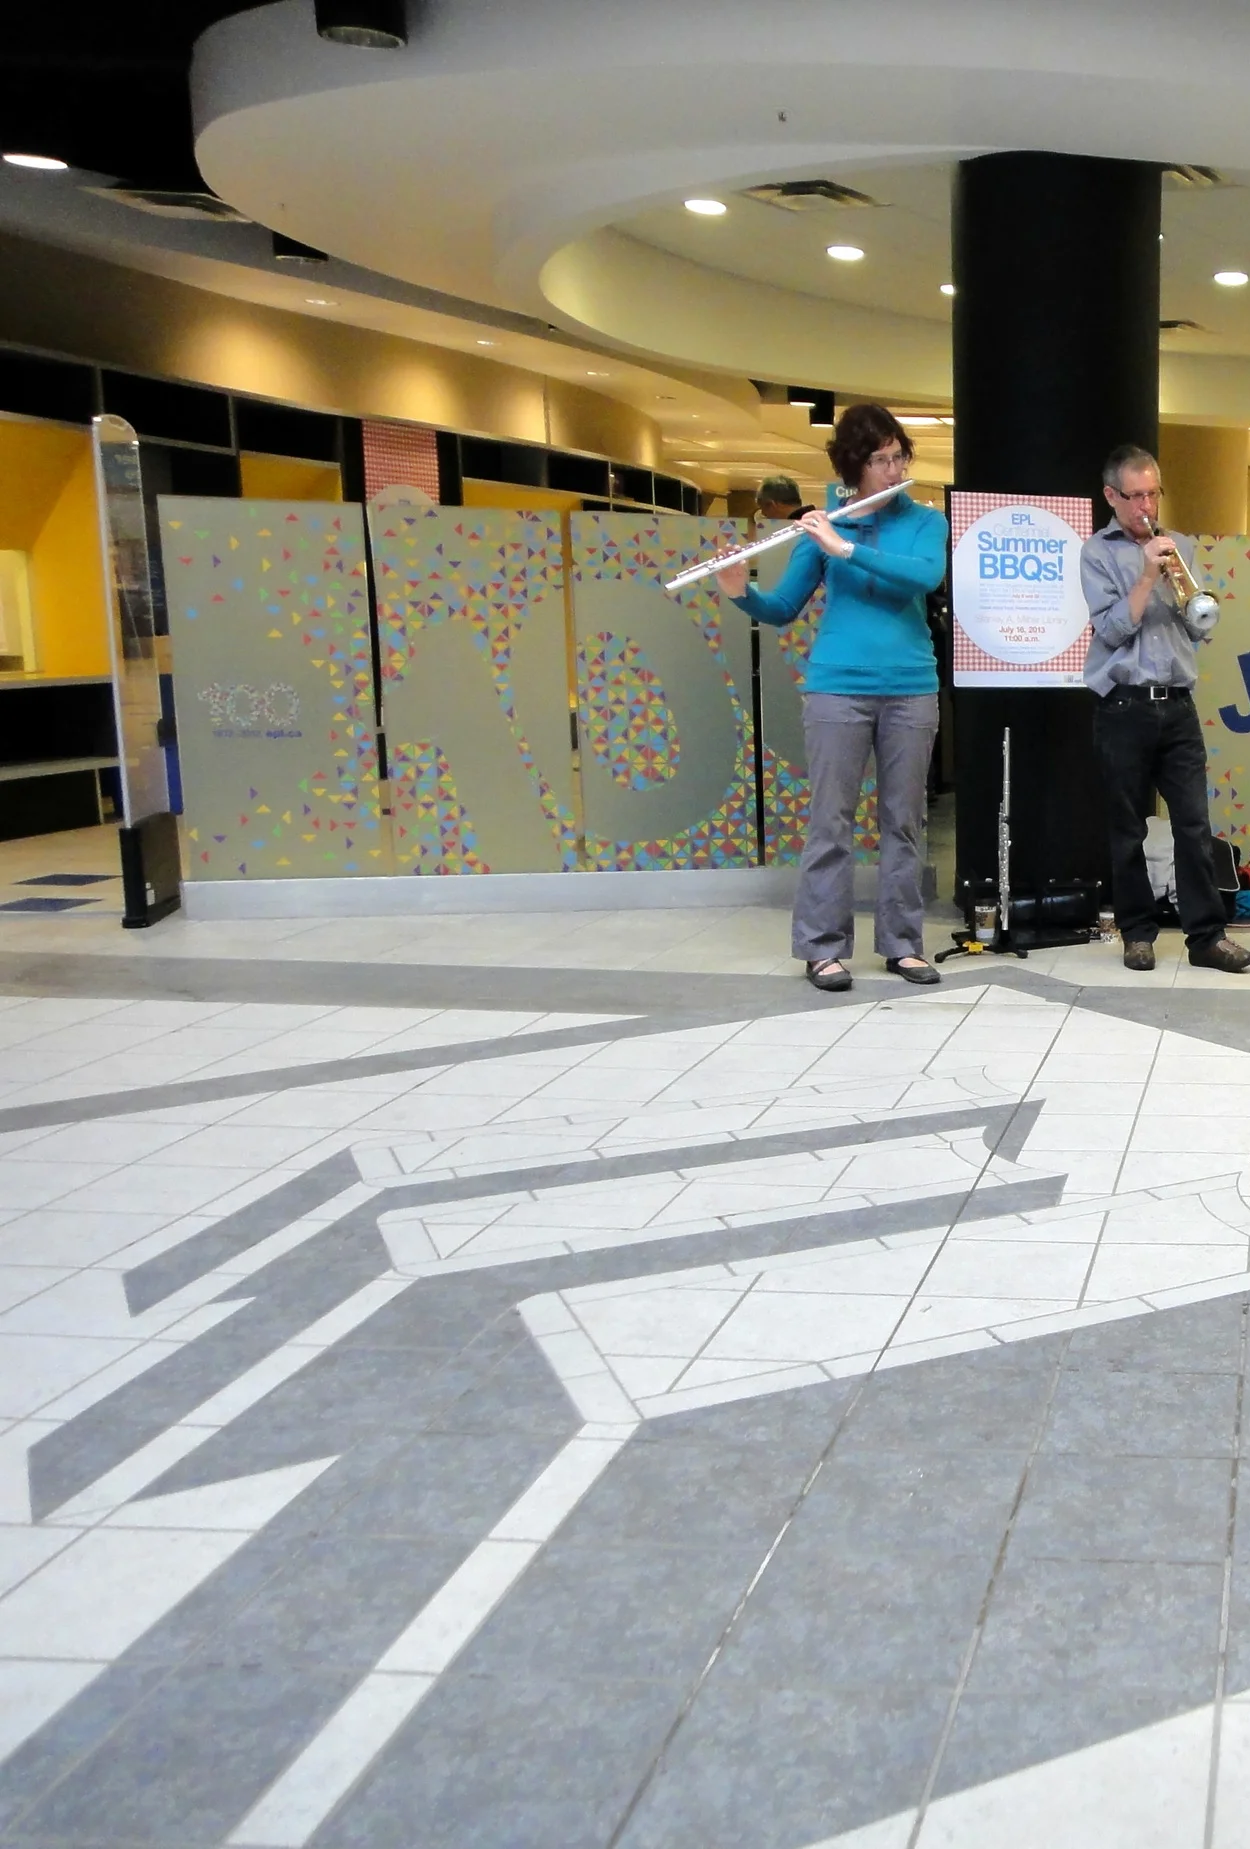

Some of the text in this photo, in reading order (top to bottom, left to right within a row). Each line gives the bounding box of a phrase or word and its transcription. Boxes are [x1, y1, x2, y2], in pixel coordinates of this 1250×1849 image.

[1011, 513, 1035, 526] EPL
[977, 530, 1068, 554] Summer
[979, 553, 1064, 583] BBQs!
[999, 626, 1014, 634] July
[1028, 626, 1046, 634] 2013
